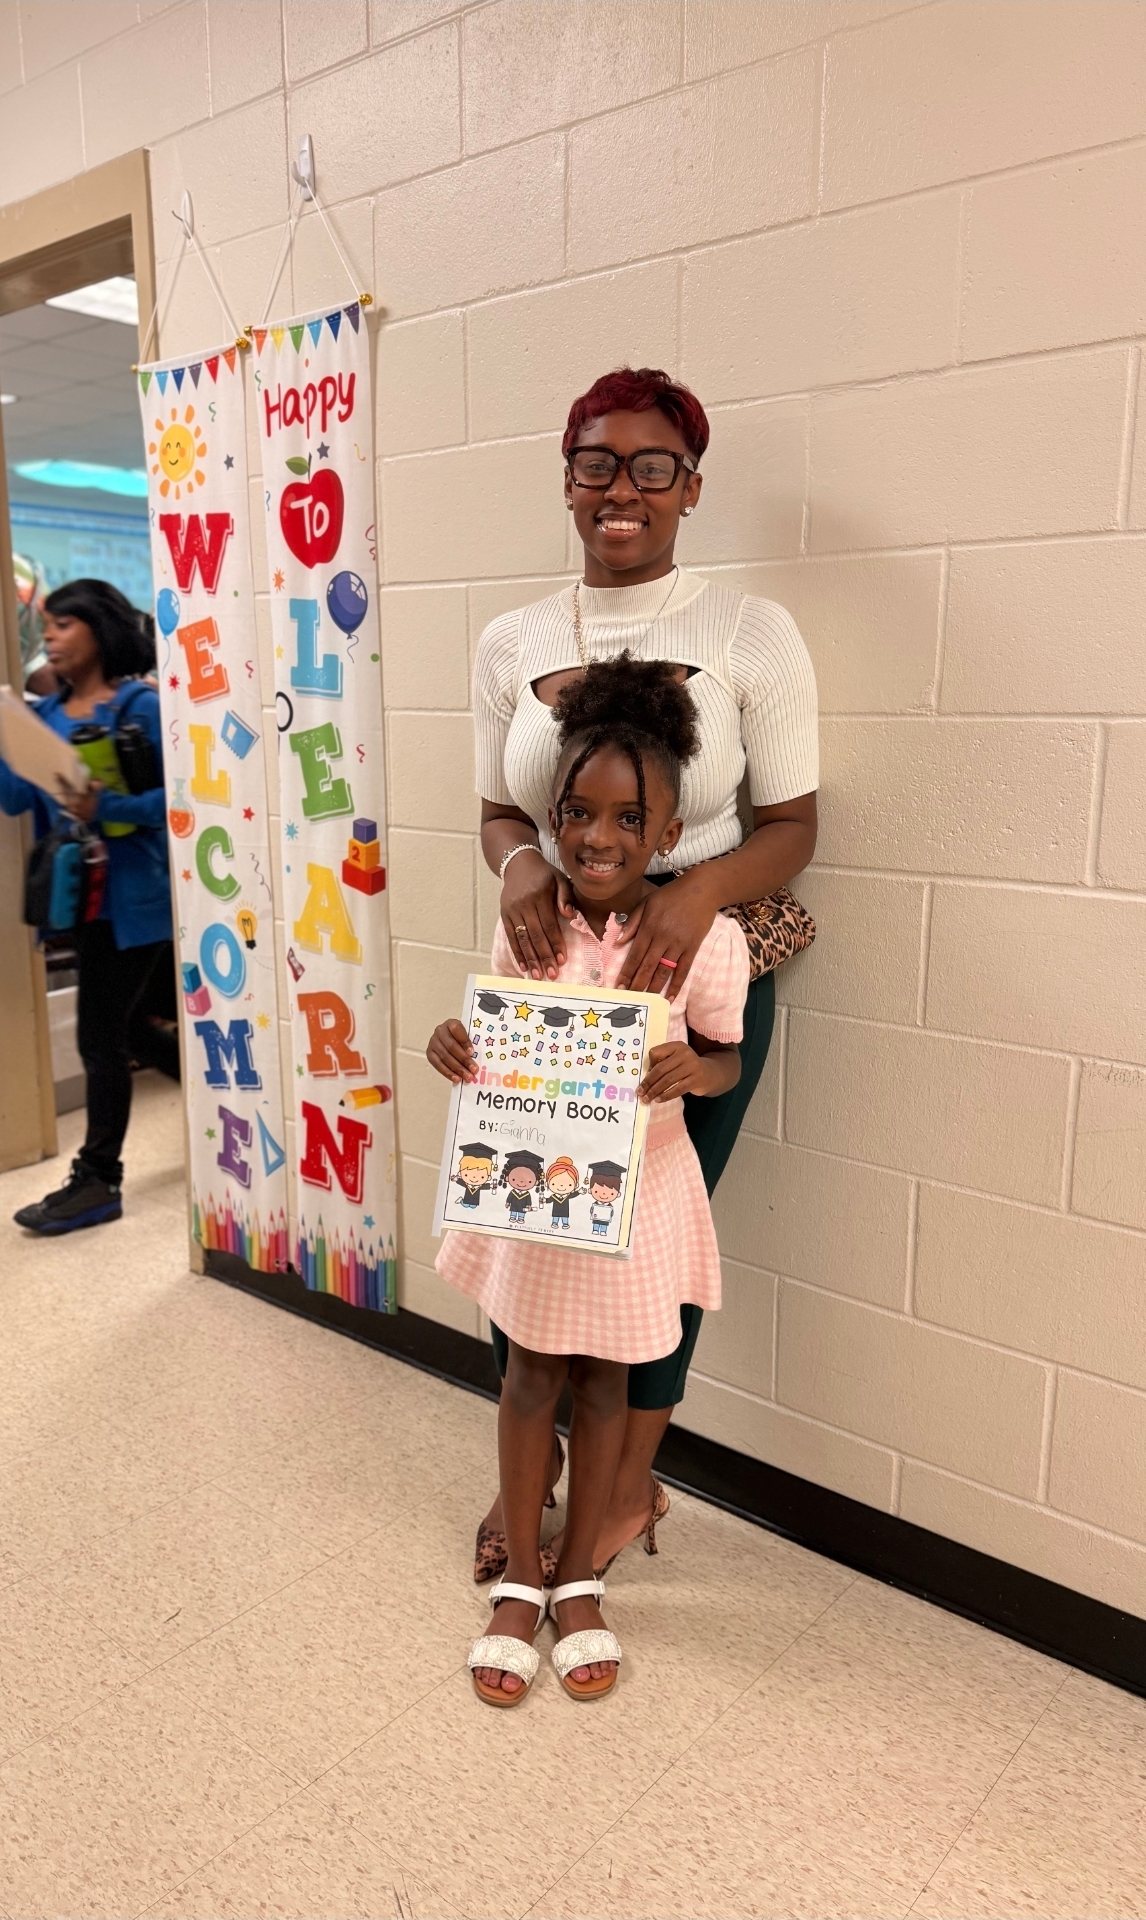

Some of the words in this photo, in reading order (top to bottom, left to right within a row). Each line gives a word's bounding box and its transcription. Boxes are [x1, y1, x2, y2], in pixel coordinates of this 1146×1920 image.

[264, 371, 356, 440] Happy
[159, 512, 263, 1190] WELCOME
[288, 597, 373, 1205] LEARN
[470, 1065, 635, 1103] indergarten
[476, 1090, 557, 1119] Memory
[479, 1119, 499, 1133] By:
[499, 1120, 546, 1146] Gianna
